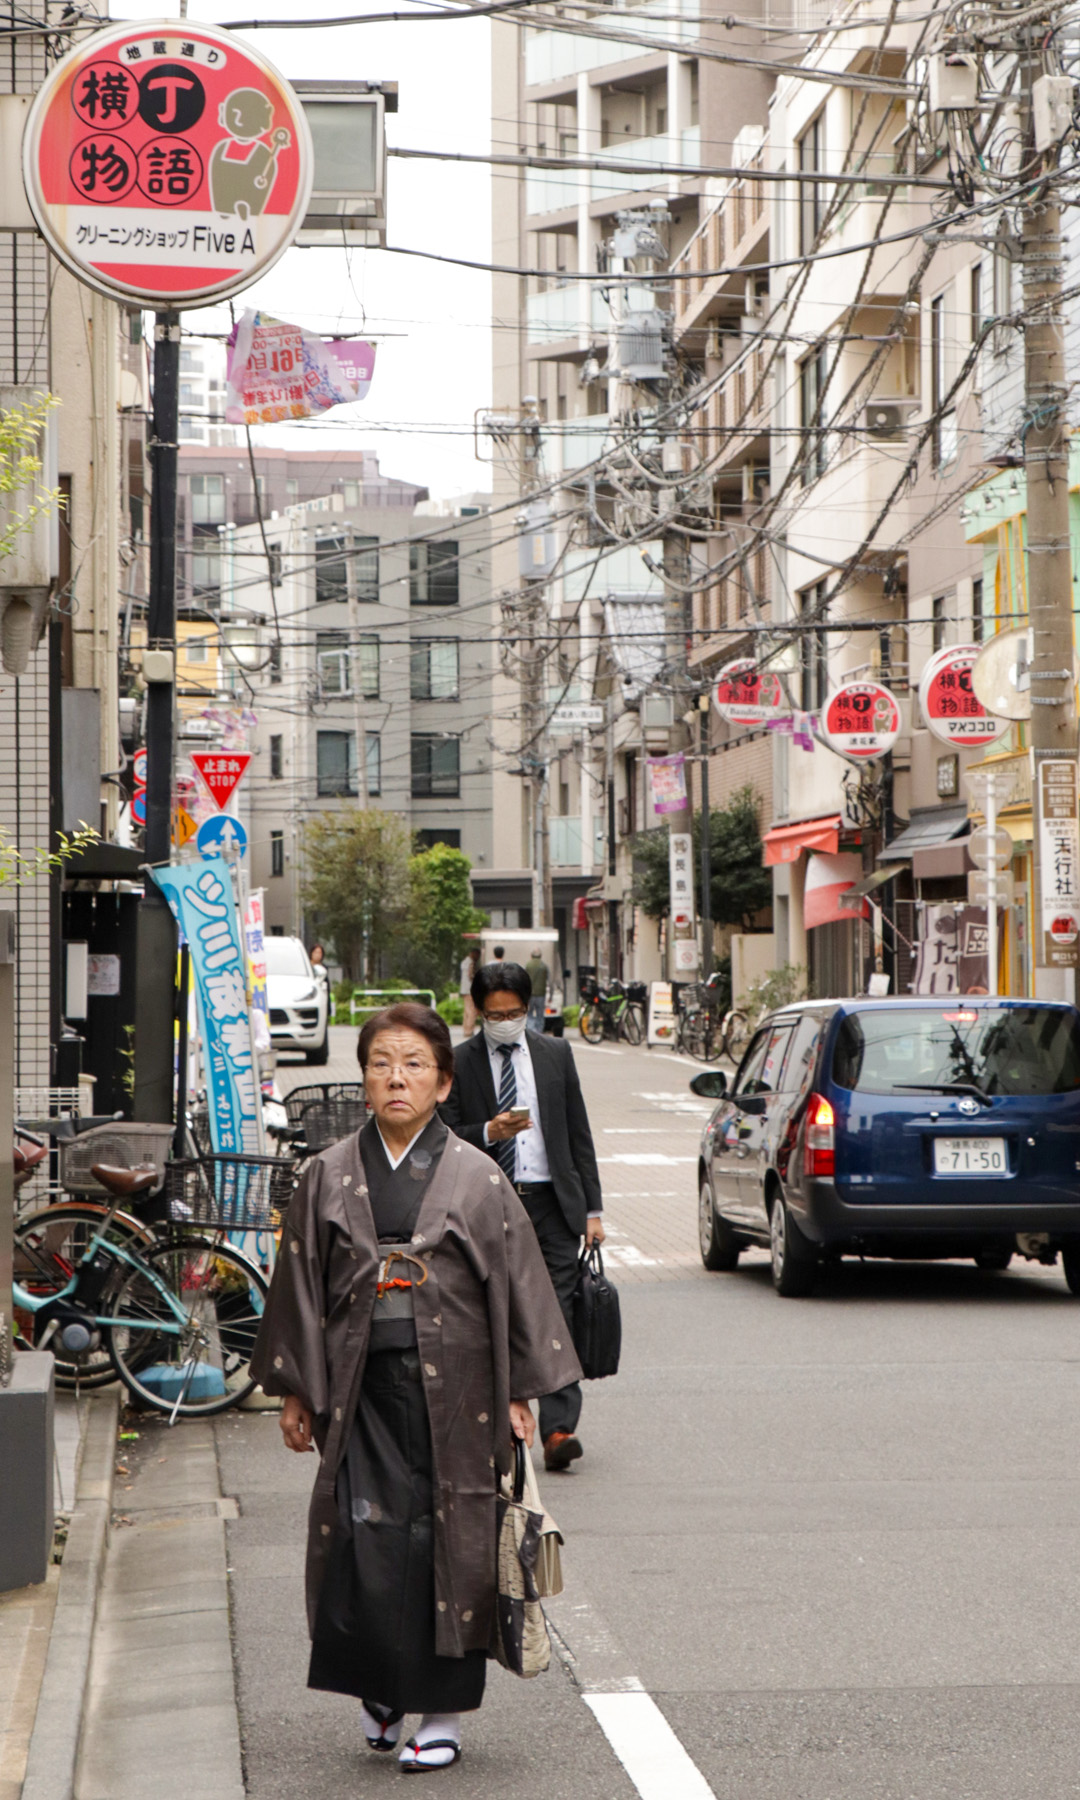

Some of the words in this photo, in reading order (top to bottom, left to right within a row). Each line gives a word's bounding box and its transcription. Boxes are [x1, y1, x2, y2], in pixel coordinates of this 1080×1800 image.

[125, 40, 219, 64] 地蔵通り
[79, 70, 195, 124] 横丁
[80, 143, 194, 195] 物語
[76, 224, 189, 248] クリーニングショップ
[193, 225, 235, 254] Five
[240, 228, 256, 255] A
[941, 696, 979, 714] 物語
[948, 721, 996, 732] マメココロ
[203, 758, 241, 773] 止まれ
[209, 775, 236, 788] STOP
[951, 1151, 1001, 1170] 71-50
